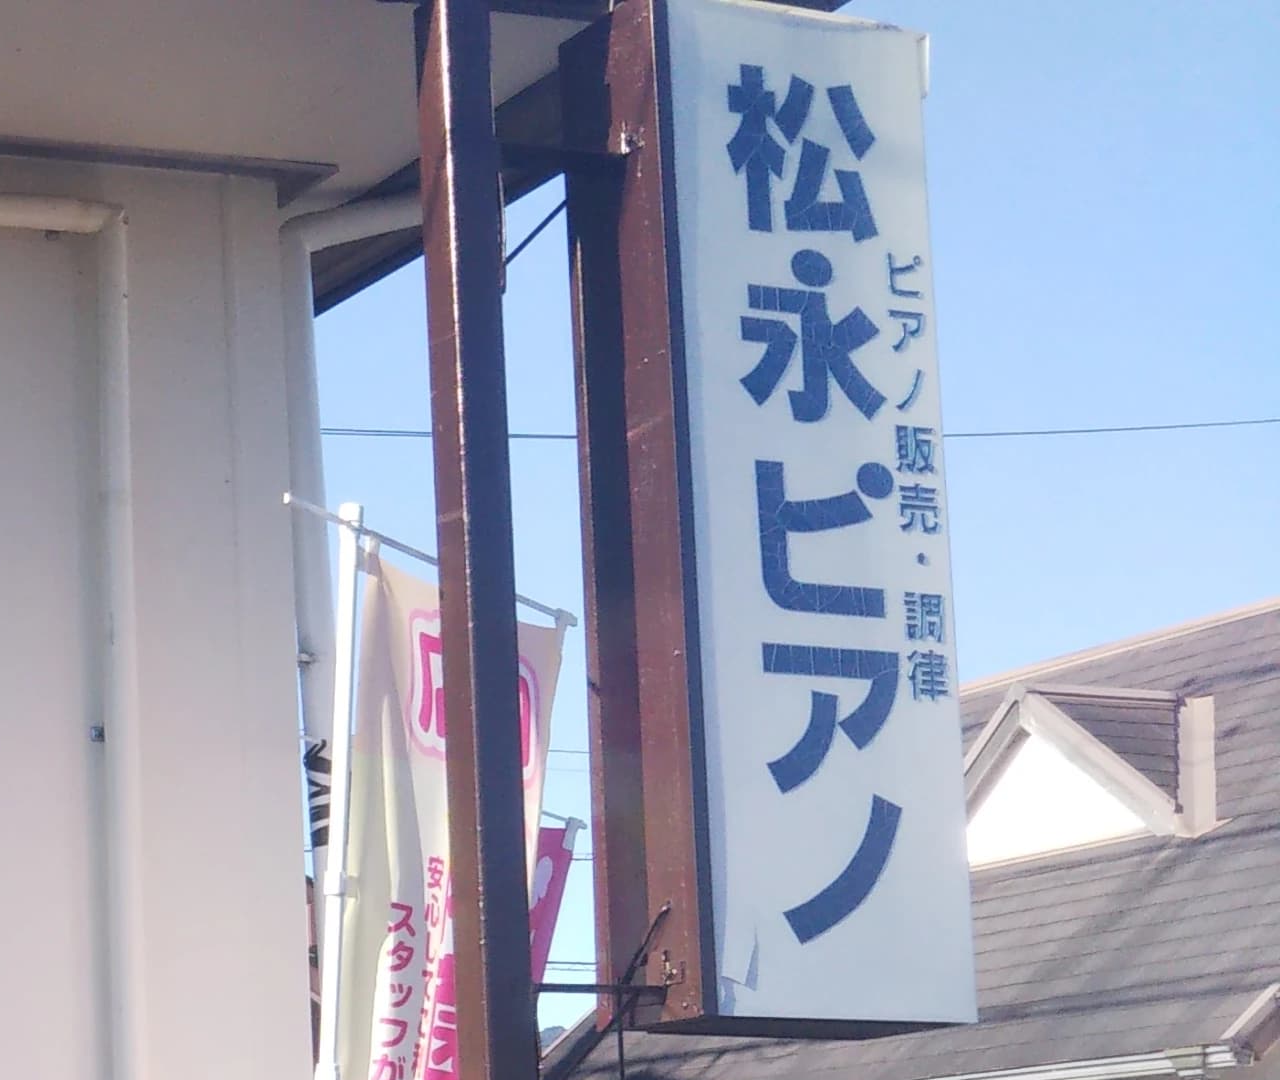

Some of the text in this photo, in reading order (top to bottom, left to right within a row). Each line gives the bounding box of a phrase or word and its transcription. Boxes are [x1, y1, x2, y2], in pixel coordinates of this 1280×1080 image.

[726, 62, 903, 946] 松永ピアノ
[883, 250, 952, 703] ピアノ販売・調律
